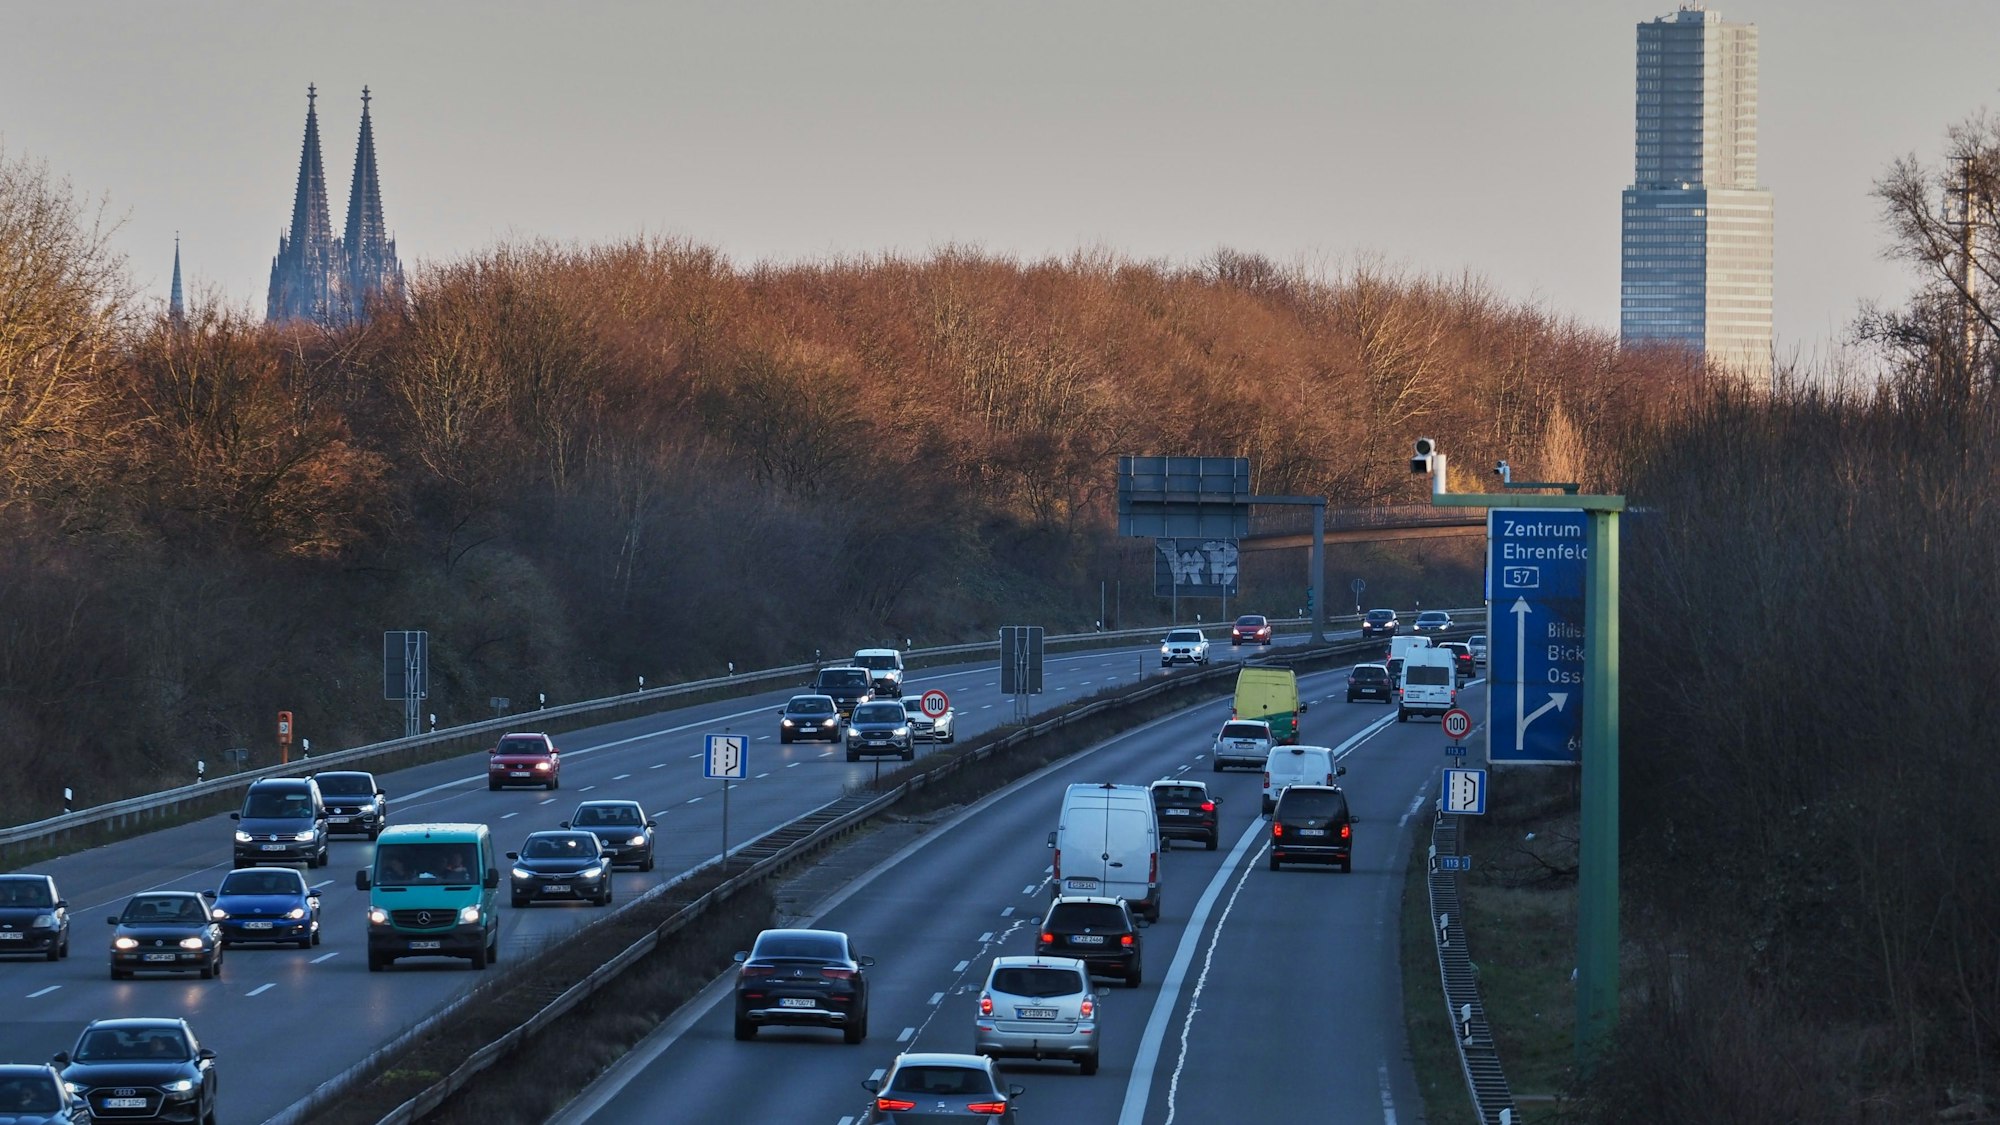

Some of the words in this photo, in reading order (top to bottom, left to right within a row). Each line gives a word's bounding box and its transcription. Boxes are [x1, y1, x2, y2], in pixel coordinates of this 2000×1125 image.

[1503, 520, 1581, 537] Zentrum
[1513, 570, 1530, 584] 57
[1548, 667, 1584, 683] Oss
[926, 697, 944, 711] 100
[1448, 717, 1466, 731] 100
